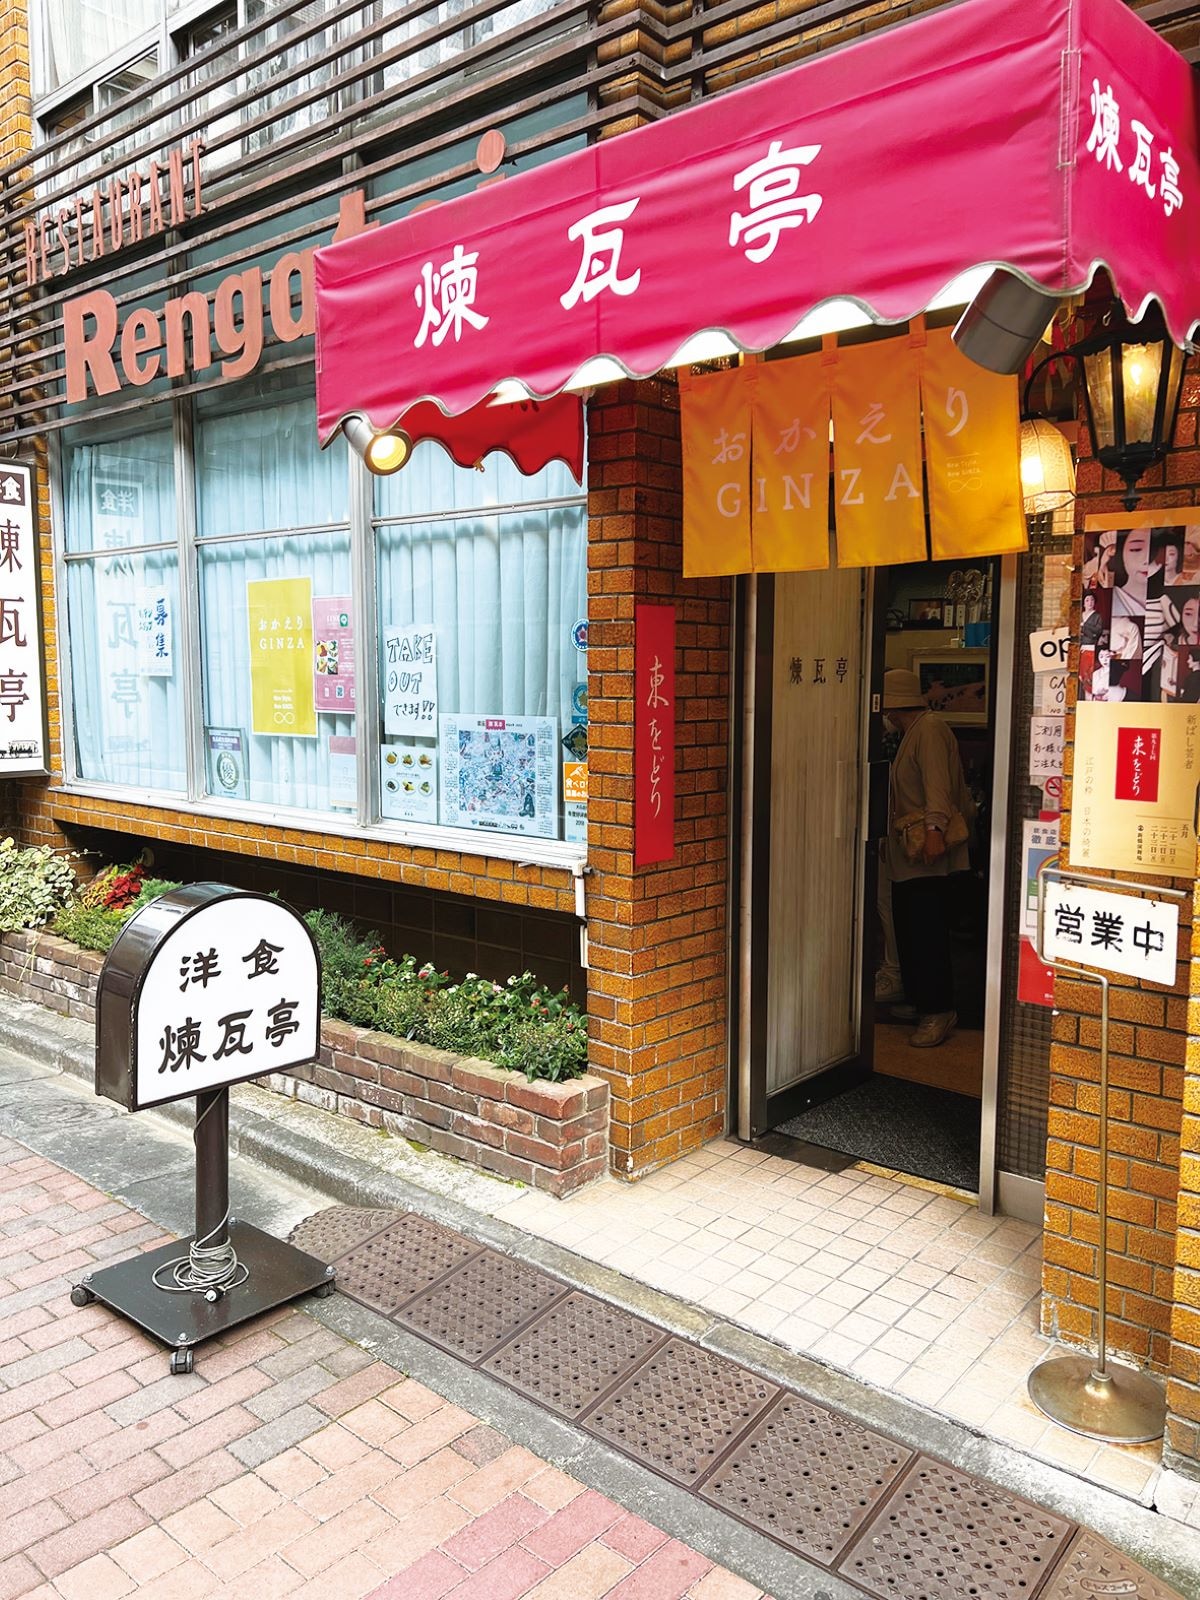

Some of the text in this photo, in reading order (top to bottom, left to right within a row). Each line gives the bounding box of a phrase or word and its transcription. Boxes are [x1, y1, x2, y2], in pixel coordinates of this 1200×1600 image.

[1086, 79, 1184, 218] 煉瓦亭
[24, 137, 206, 286] RESTAURANT
[413, 139, 823, 350] 煉瓦亭
[712, 386, 969, 465] おかえり
[0, 475, 22, 502] 食
[716, 462, 921, 519] GINZA
[258, 615, 304, 632] おかえり
[259, 636, 305, 650] GINZA
[386, 632, 433, 664] TAKE
[387, 669, 423, 695] OUT
[646, 655, 670, 819] 東をどり
[565, 777, 588, 788] 食べロ
[1131, 735, 1147, 797] 東をどり
[1054, 902, 1165, 960] 営業中
[179, 938, 285, 993] 洋食
[157, 997, 301, 1075] 煉瓦亭
